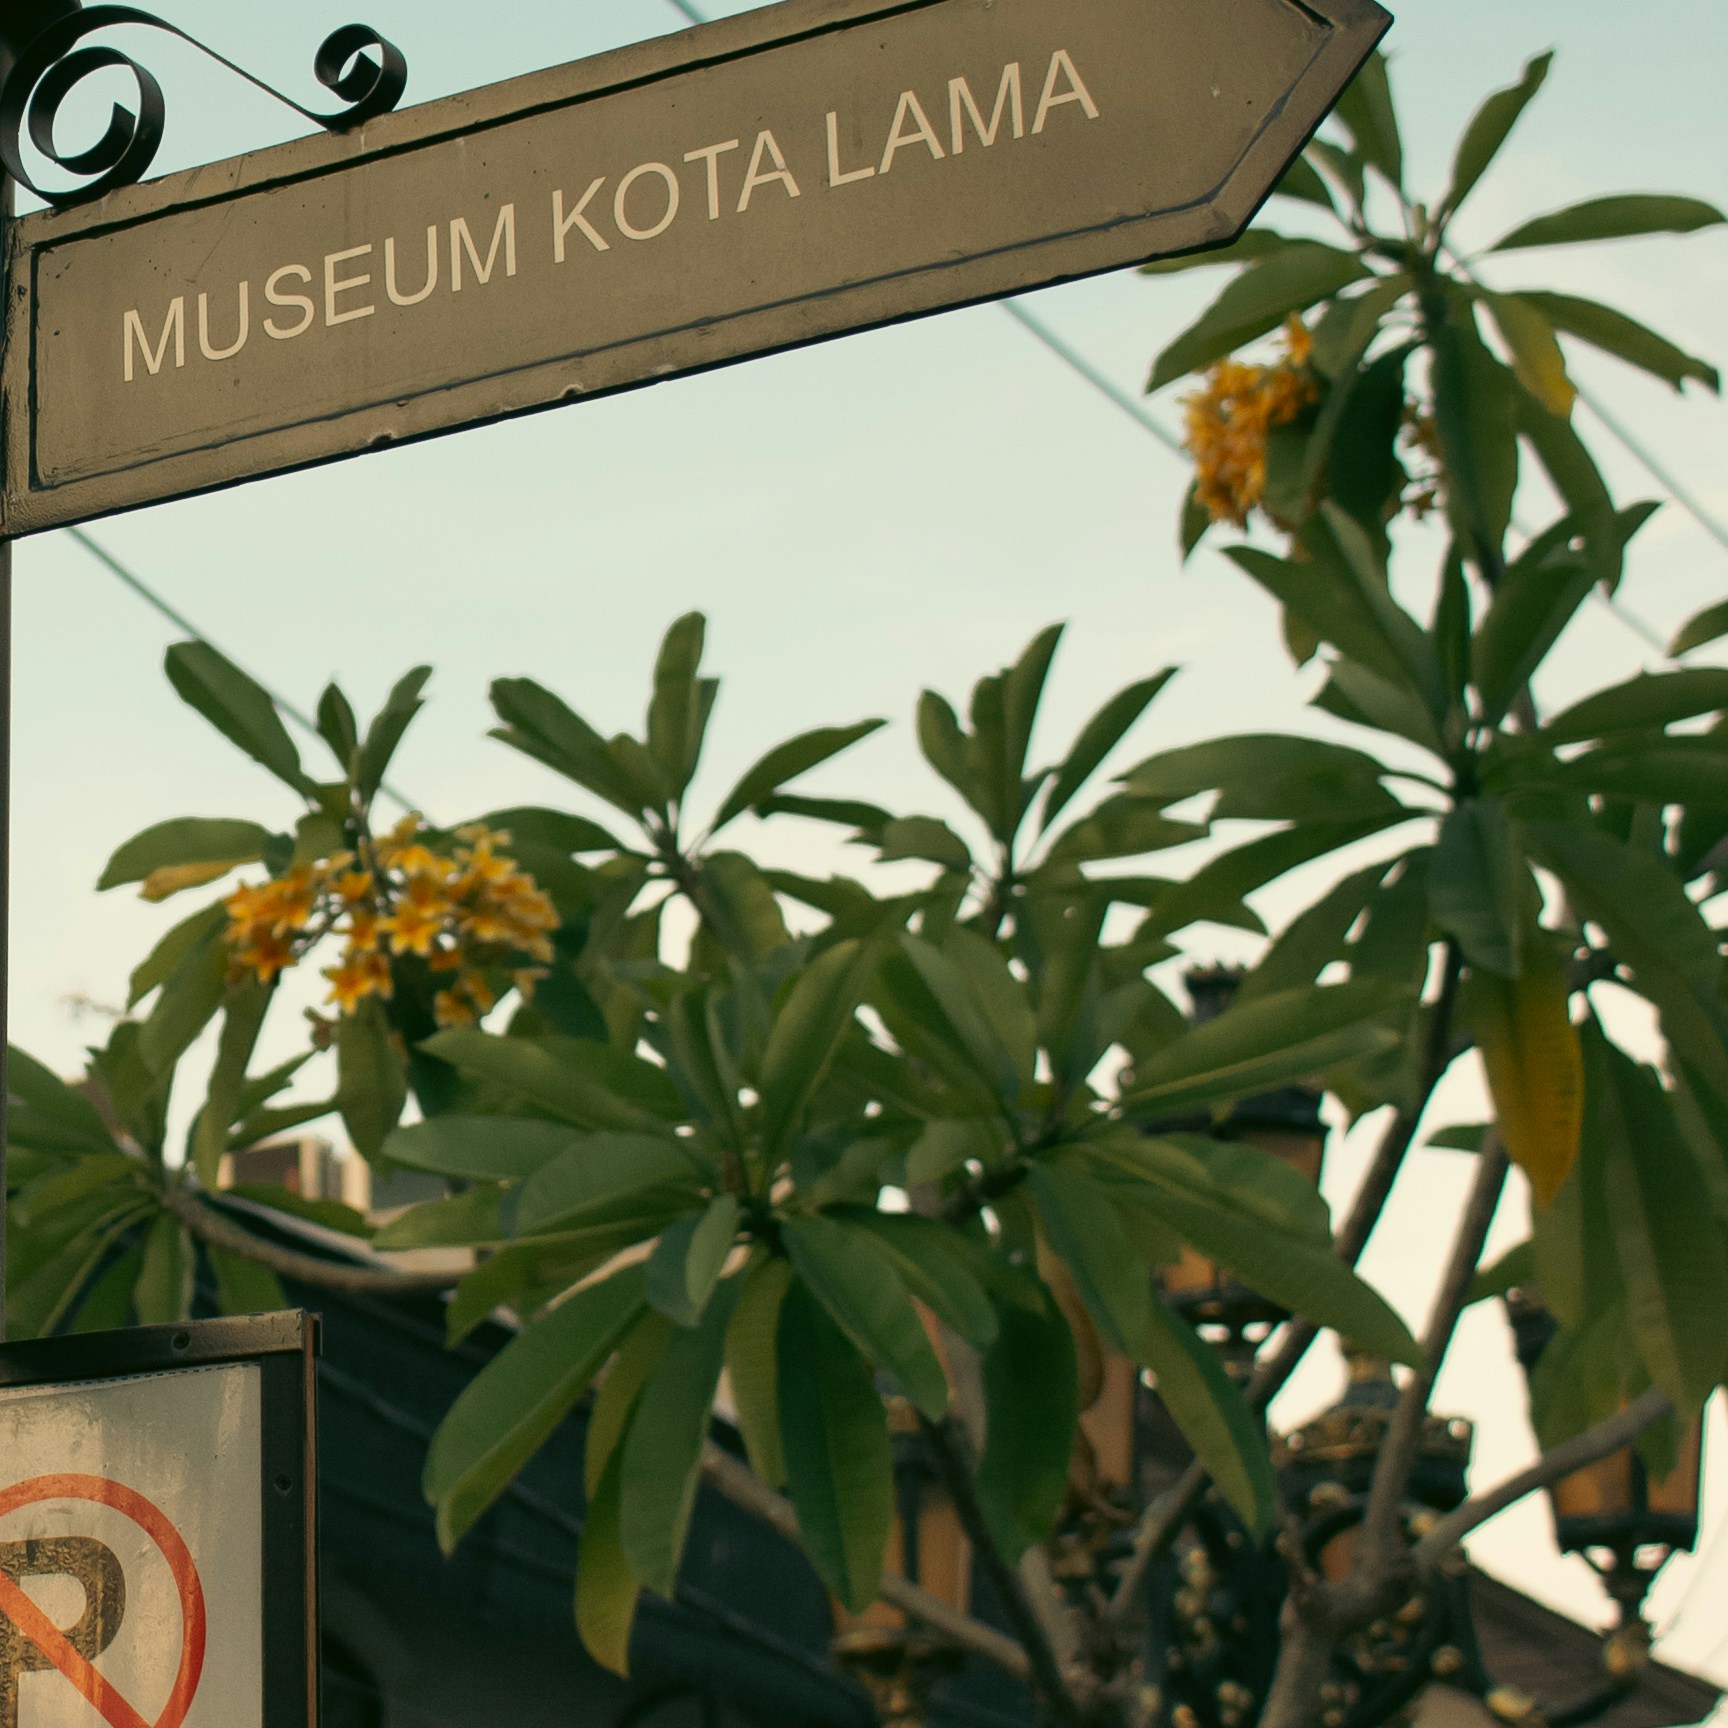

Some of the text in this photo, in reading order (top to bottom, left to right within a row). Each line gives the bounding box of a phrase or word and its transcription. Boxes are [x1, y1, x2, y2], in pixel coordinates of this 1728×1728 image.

[123, 48, 1100, 381] MUSEUM KOTA LAMA
